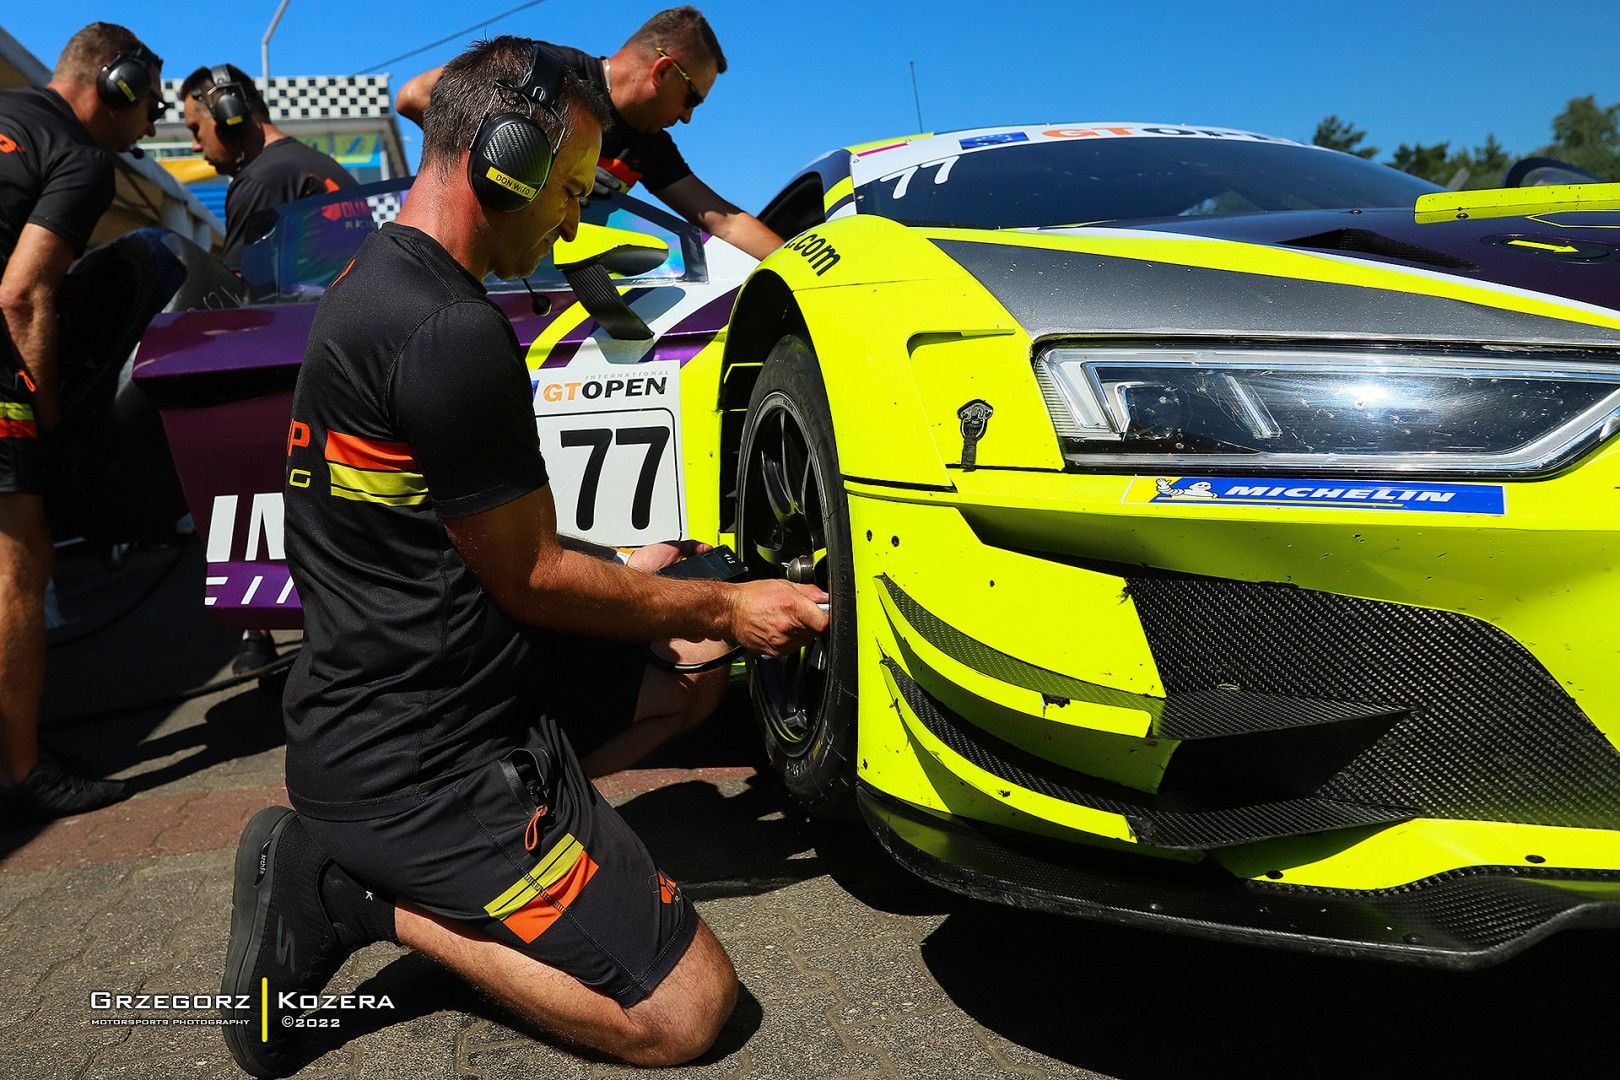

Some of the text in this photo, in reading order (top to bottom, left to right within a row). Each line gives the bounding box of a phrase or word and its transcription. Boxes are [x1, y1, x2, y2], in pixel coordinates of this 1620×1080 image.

[495, 174, 513, 188] DON
[879, 155, 961, 200] 77
[585, 370, 669, 380] INTERNATIONAL
[543, 376, 667, 403] GTOPEN
[560, 425, 670, 531] 77
[1225, 485, 1457, 503] MICHELIN
